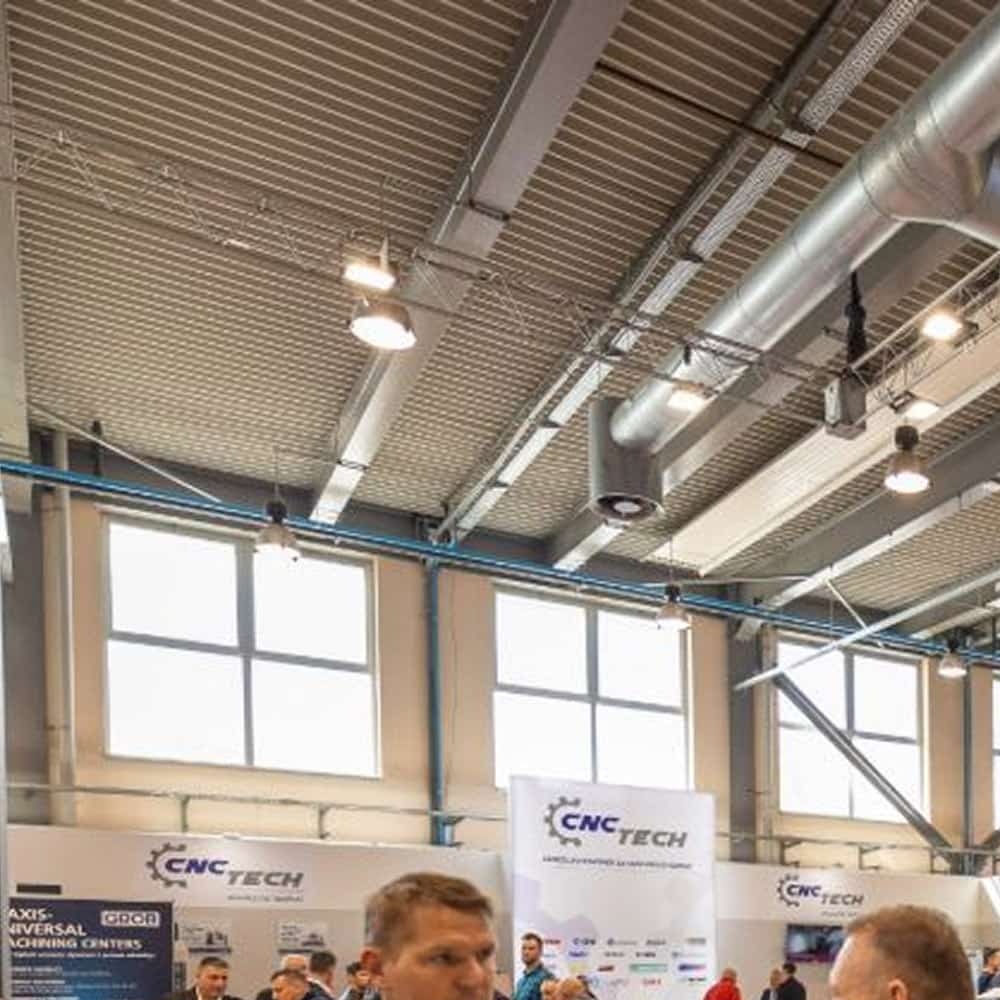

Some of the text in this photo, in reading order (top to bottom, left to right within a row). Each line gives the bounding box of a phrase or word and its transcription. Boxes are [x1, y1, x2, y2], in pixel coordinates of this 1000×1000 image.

[561, 812, 688, 848] CNC TECH
[165, 858, 304, 887] CNC TECH
[786, 884, 864, 905] CNC TECH
[9, 922, 86, 936] NIVERSAL
